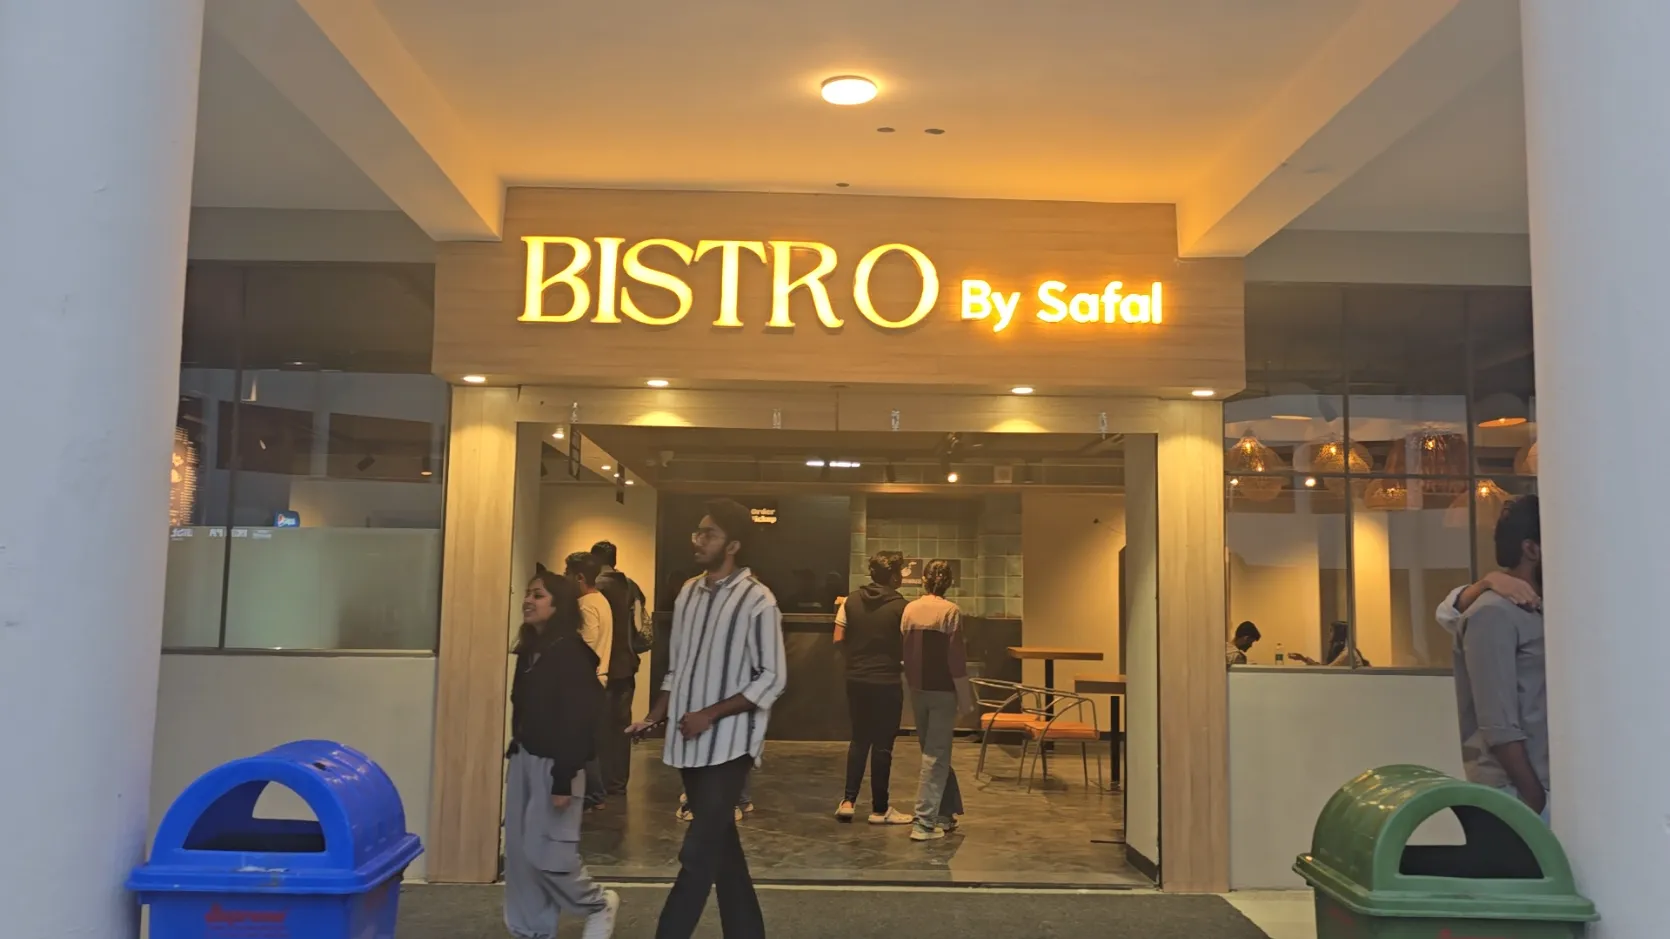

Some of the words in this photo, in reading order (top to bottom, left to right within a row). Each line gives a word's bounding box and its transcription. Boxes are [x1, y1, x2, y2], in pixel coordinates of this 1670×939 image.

[517, 235, 940, 329] BISTRO
[961, 279, 1021, 333] By
[1036, 280, 1163, 325] Safal
